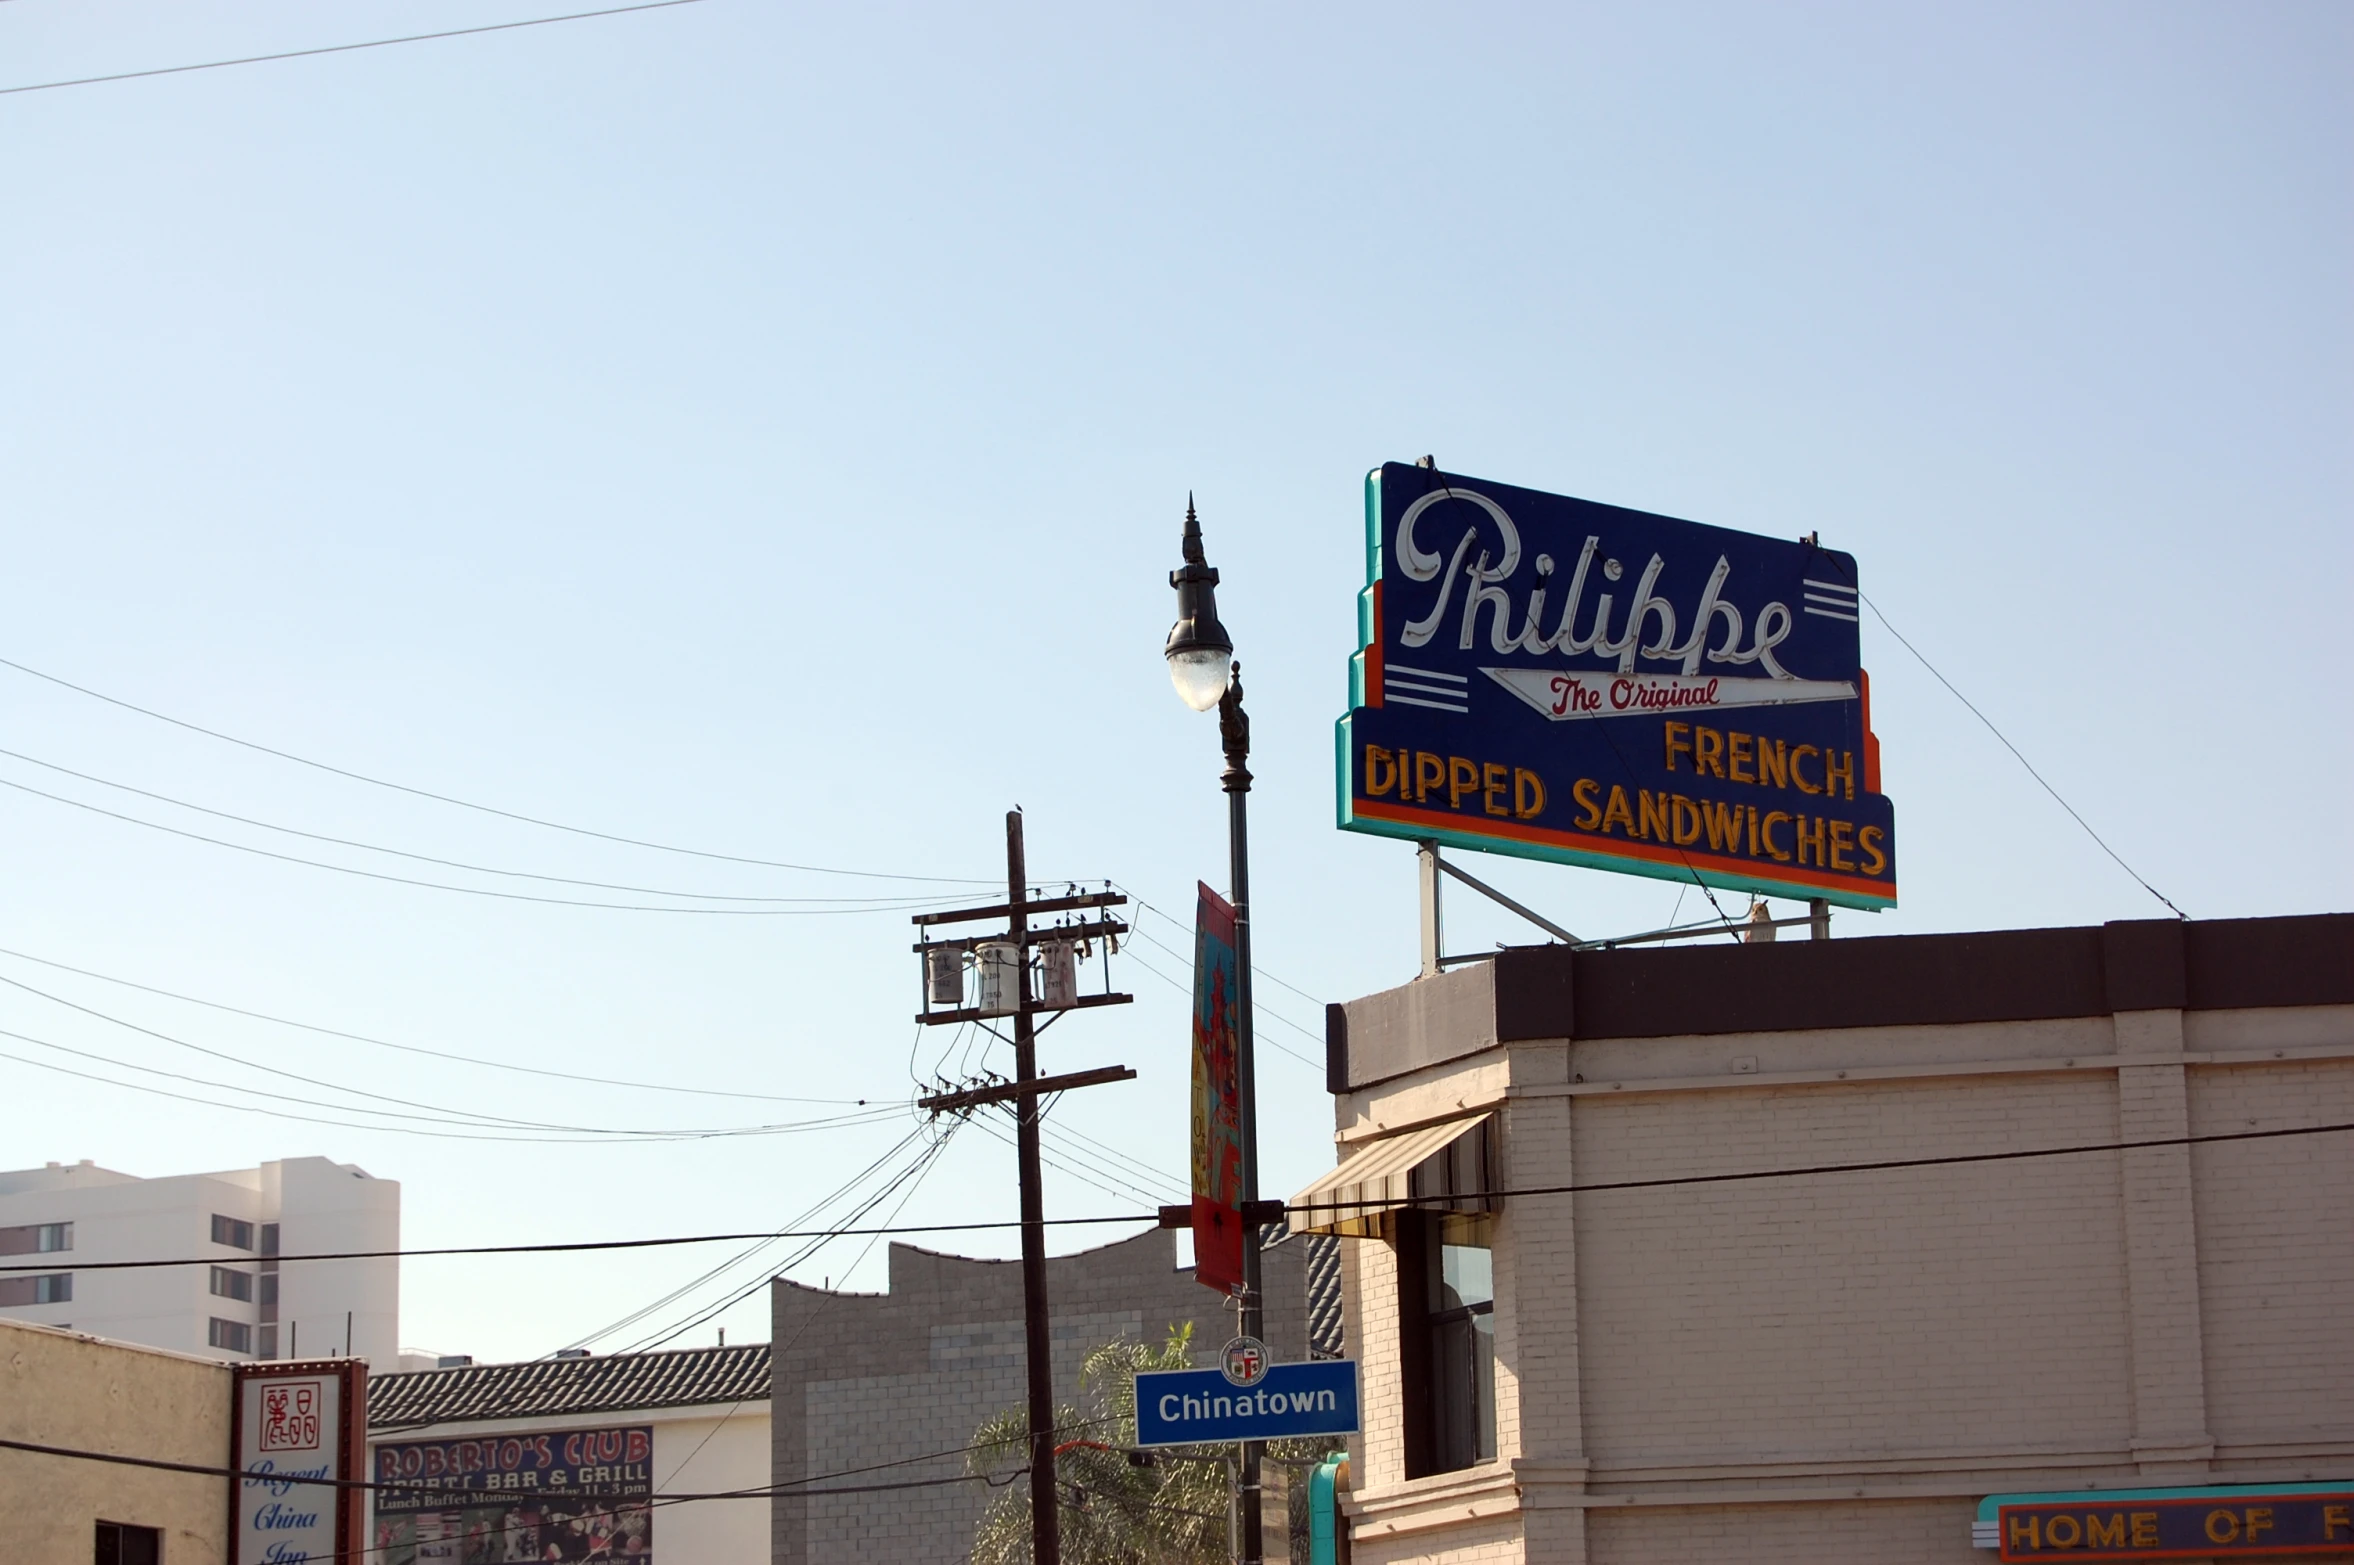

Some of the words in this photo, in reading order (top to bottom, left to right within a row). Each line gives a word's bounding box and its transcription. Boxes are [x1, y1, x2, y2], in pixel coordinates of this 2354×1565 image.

[1395, 488, 1794, 680] Philippe
[1550, 677, 1602, 715] The
[1609, 678, 1720, 712] Original
[1664, 720, 1854, 801] FRENCH
[1364, 743, 1548, 820] DIPPED
[1572, 778, 1888, 876] SANDWICHES
[1158, 1389, 1336, 1422] Chinatown
[380, 1435, 552, 1479] ROBERTO'S
[564, 1430, 649, 1466] CLUB
[244, 1459, 329, 1497] Regent
[486, 1471, 538, 1489] BAR
[549, 1468, 568, 1485] &
[578, 1463, 648, 1483] GRILL
[379, 1495, 420, 1510] Lunch
[424, 1492, 468, 1507] Buffet
[611, 1482, 620, 1494] 3
[624, 1483, 647, 1496] pm
[254, 1503, 318, 1531] China
[2009, 1511, 2159, 1550] HOME
[2204, 1508, 2274, 1545] OF
